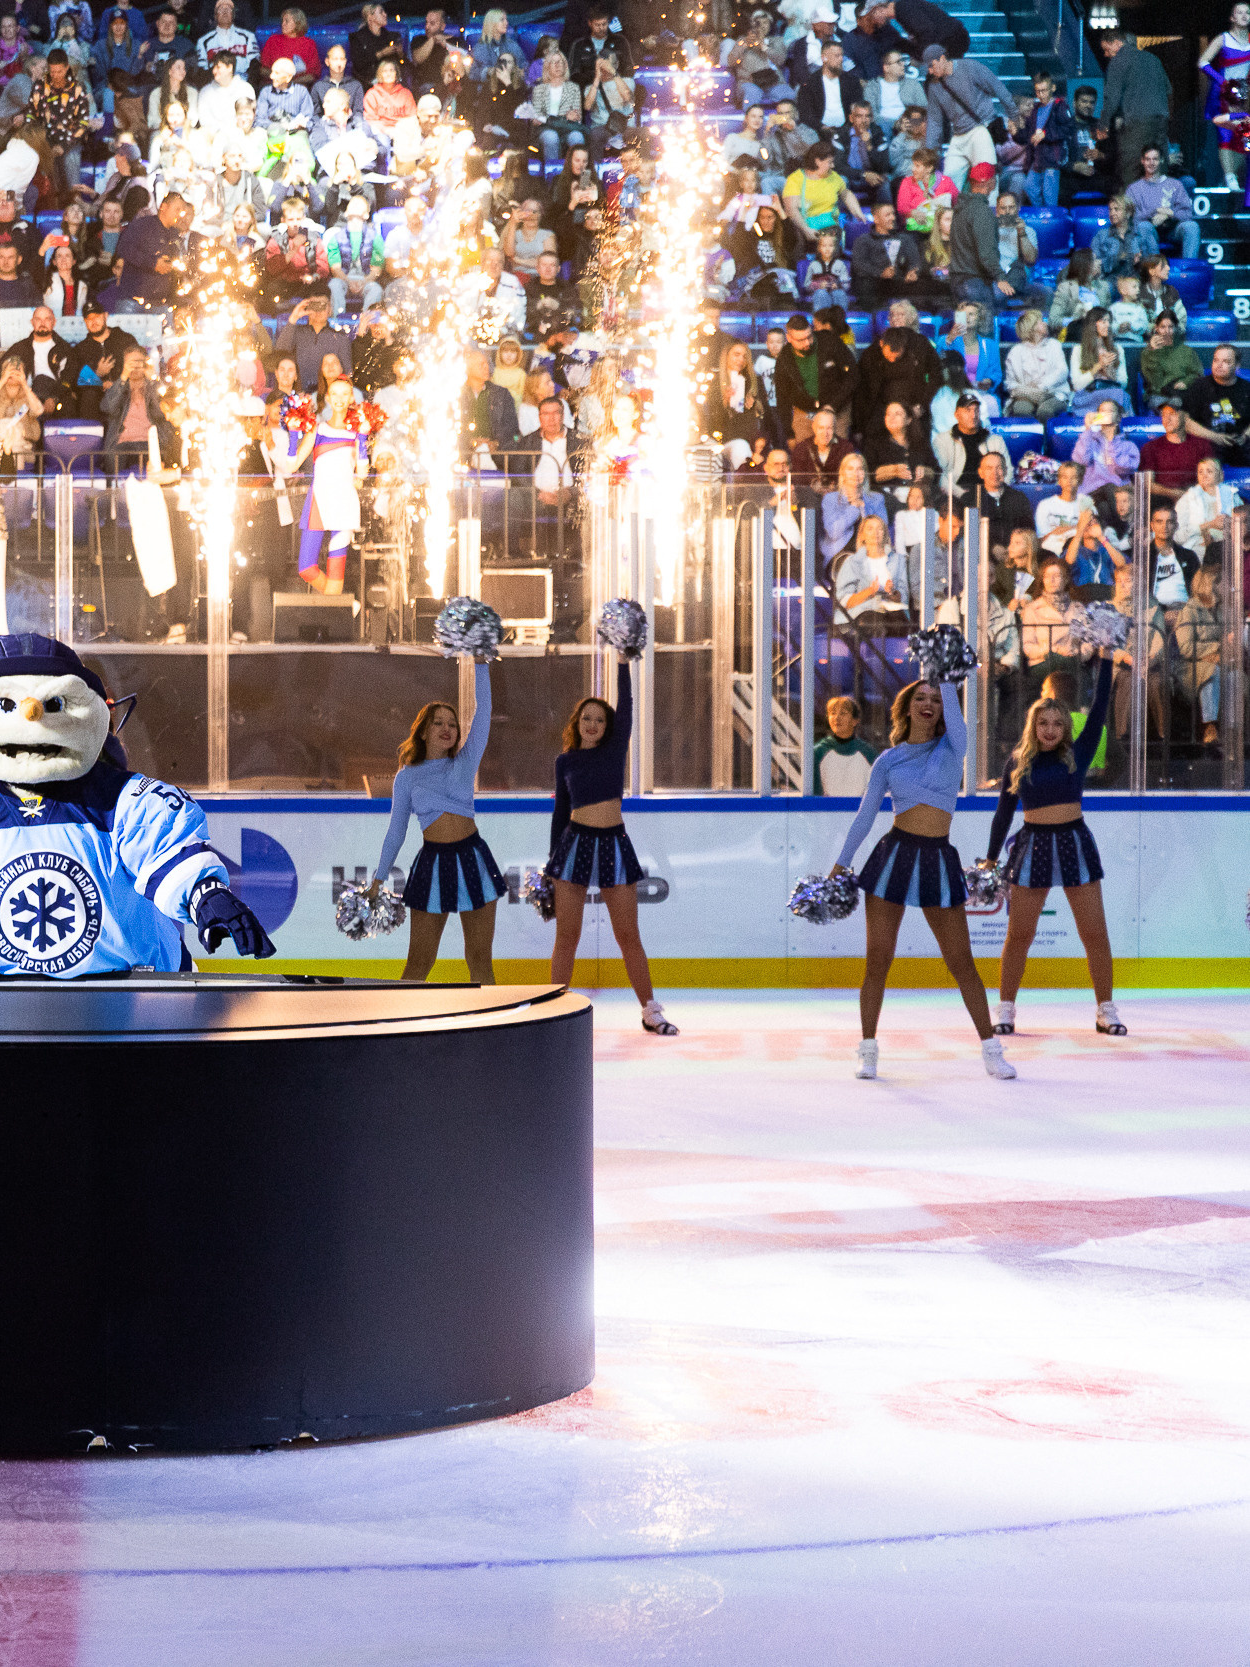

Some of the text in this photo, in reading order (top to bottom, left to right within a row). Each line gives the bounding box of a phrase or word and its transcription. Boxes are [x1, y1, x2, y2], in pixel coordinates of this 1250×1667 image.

[1207, 243, 1224, 264] 9
[1233, 297, 1250, 319] 8
[38, 855, 70, 872] КЛУБ
[69, 865, 99, 907] СИБИРЬ
[66, 918, 99, 964] ОБЛАСТЬ
